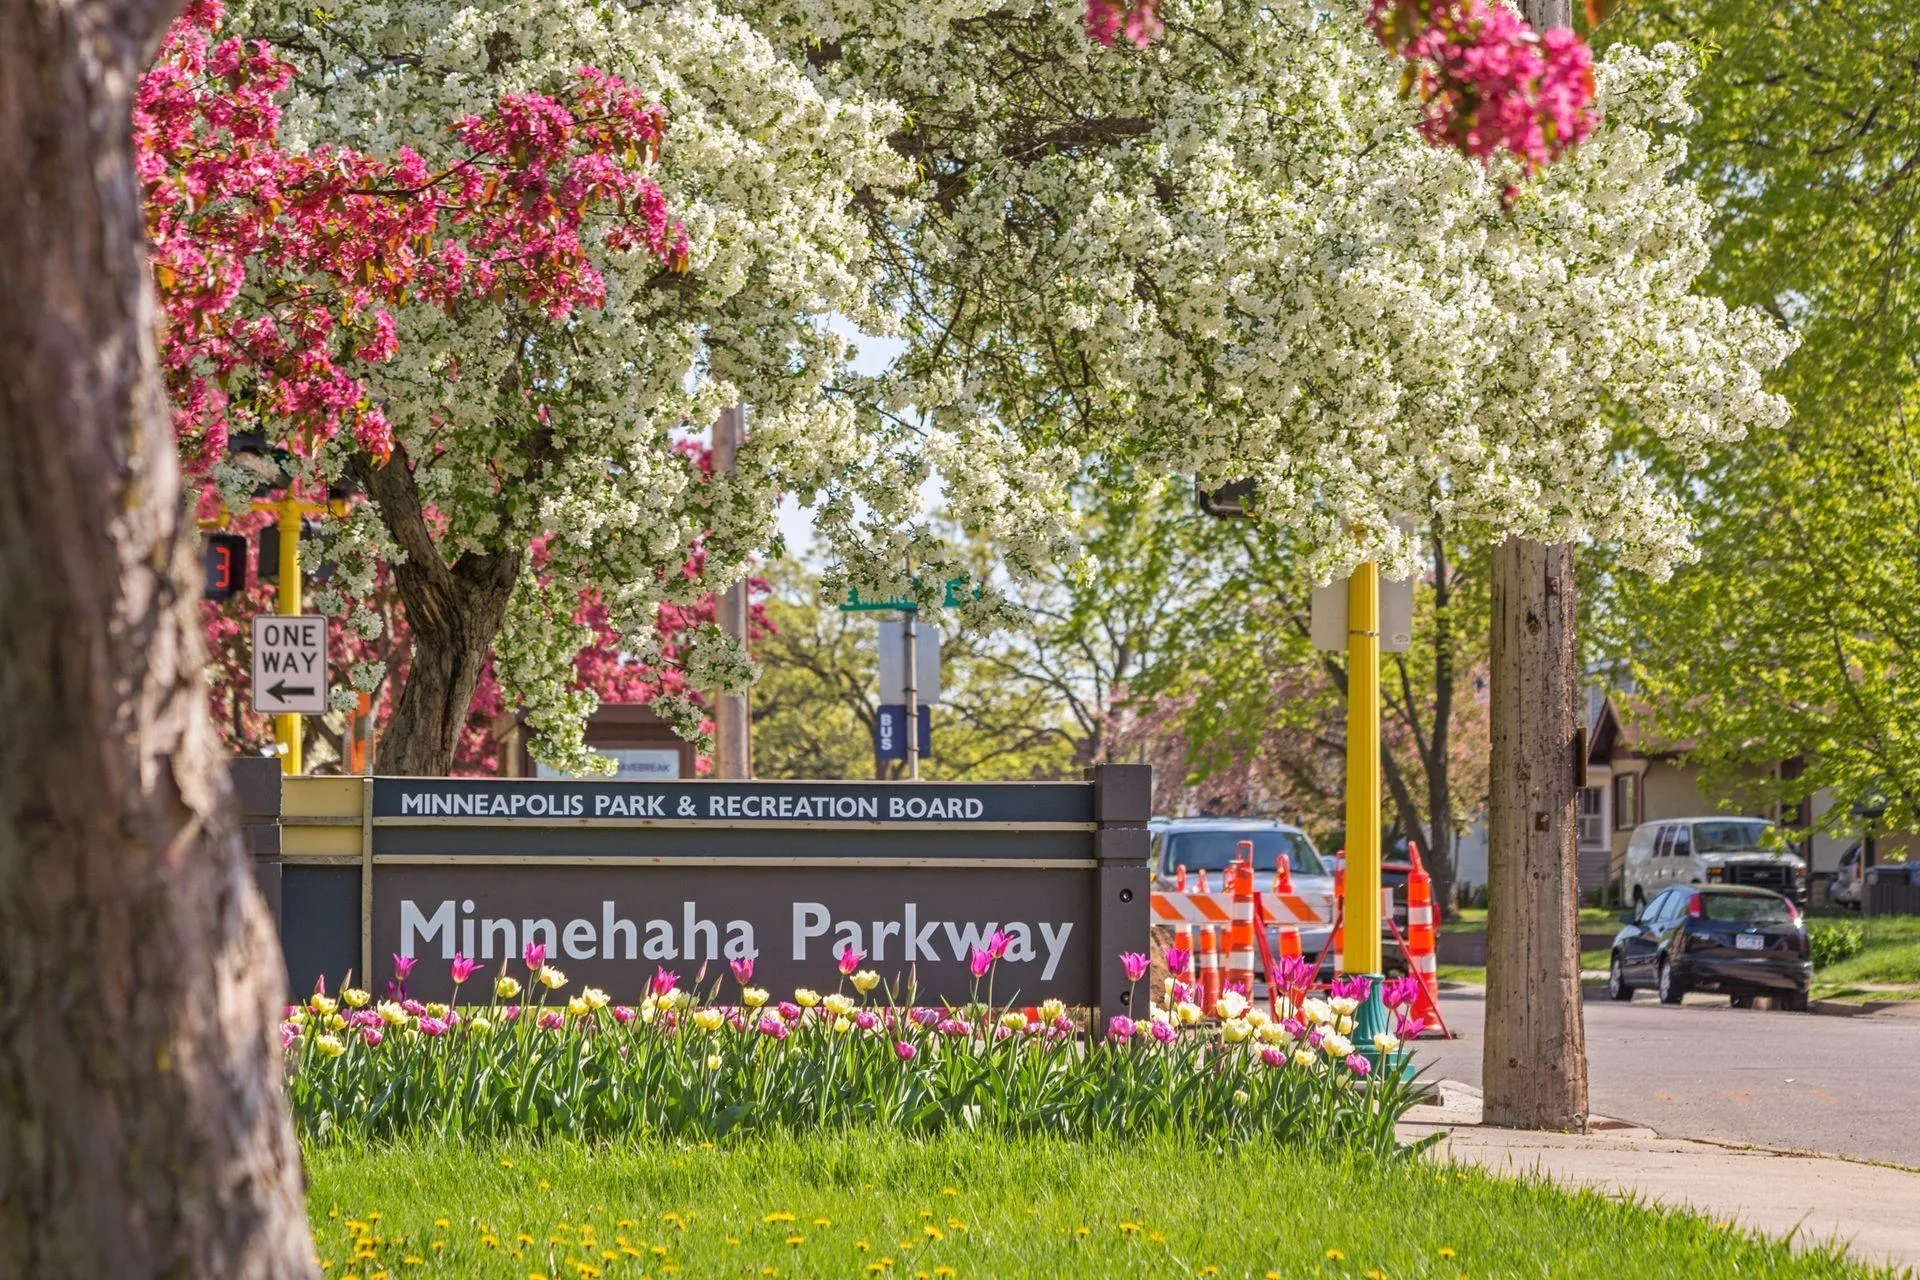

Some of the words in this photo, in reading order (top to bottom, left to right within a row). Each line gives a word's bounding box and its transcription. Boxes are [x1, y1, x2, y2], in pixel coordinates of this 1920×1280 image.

[215, 547, 230, 588] 3
[264, 625, 316, 647] ONE
[262, 651, 317, 674] WAY
[880, 713, 892, 751] BUS
[401, 793, 584, 816] MINNEAPOLIS
[595, 795, 666, 816] PARK
[676, 795, 698, 817] &
[709, 796, 878, 818] RECREATION
[889, 797, 984, 819] BOARD
[400, 899, 759, 960] Minnehaha
[792, 902, 1074, 981] Parkway
